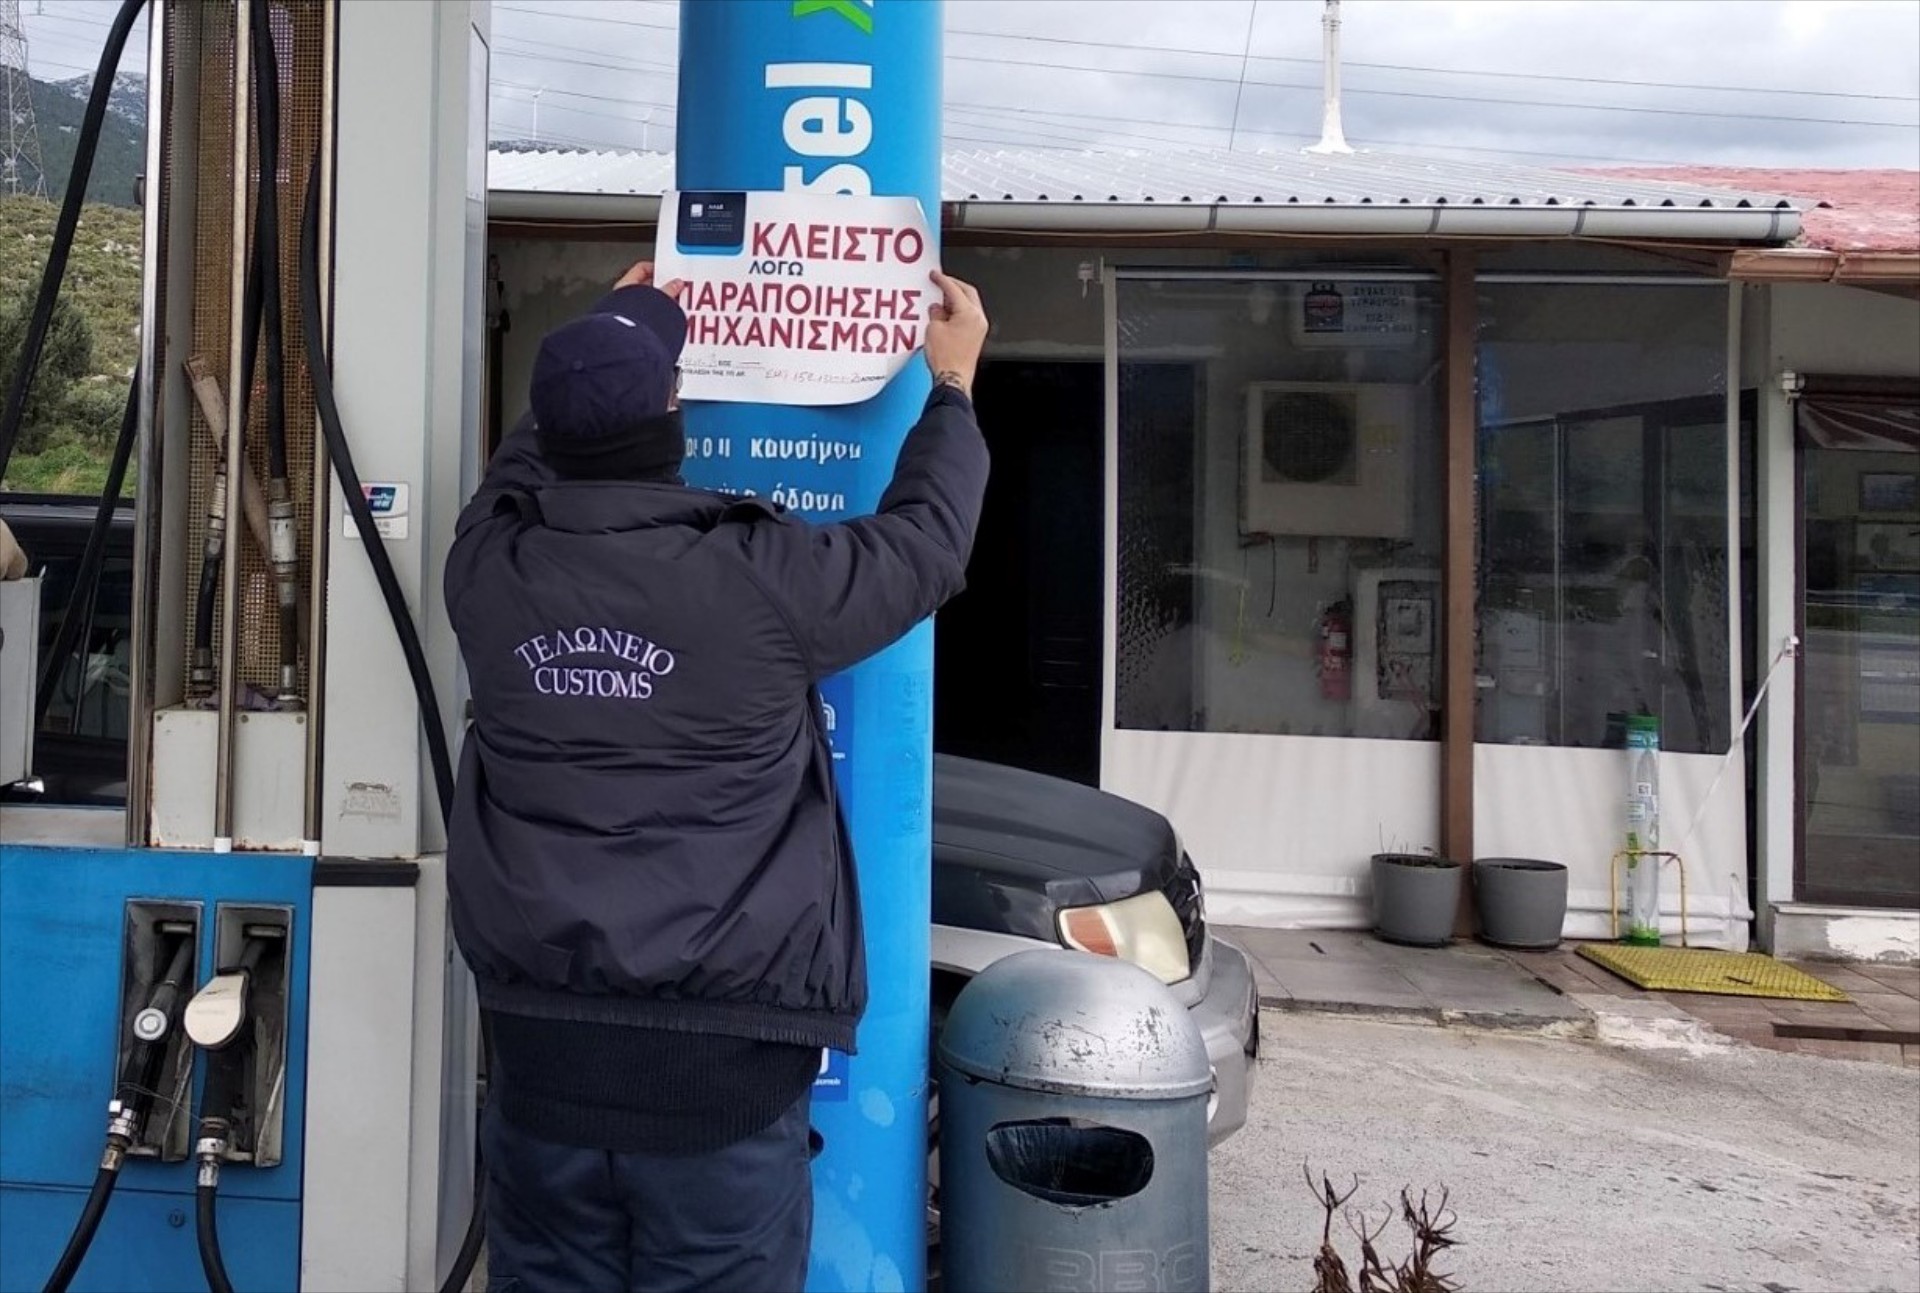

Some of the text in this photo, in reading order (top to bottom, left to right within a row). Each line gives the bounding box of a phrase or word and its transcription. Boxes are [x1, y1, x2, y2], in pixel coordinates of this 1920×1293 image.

[751, 222, 924, 264] ΚΛΕΙΣΤΟ
[748, 260, 804, 276] ΛΟΓΩ
[514, 626, 675, 676] ΤΕΛΩΝΕΙΟ
[534, 666, 653, 699] CUSTOMS
